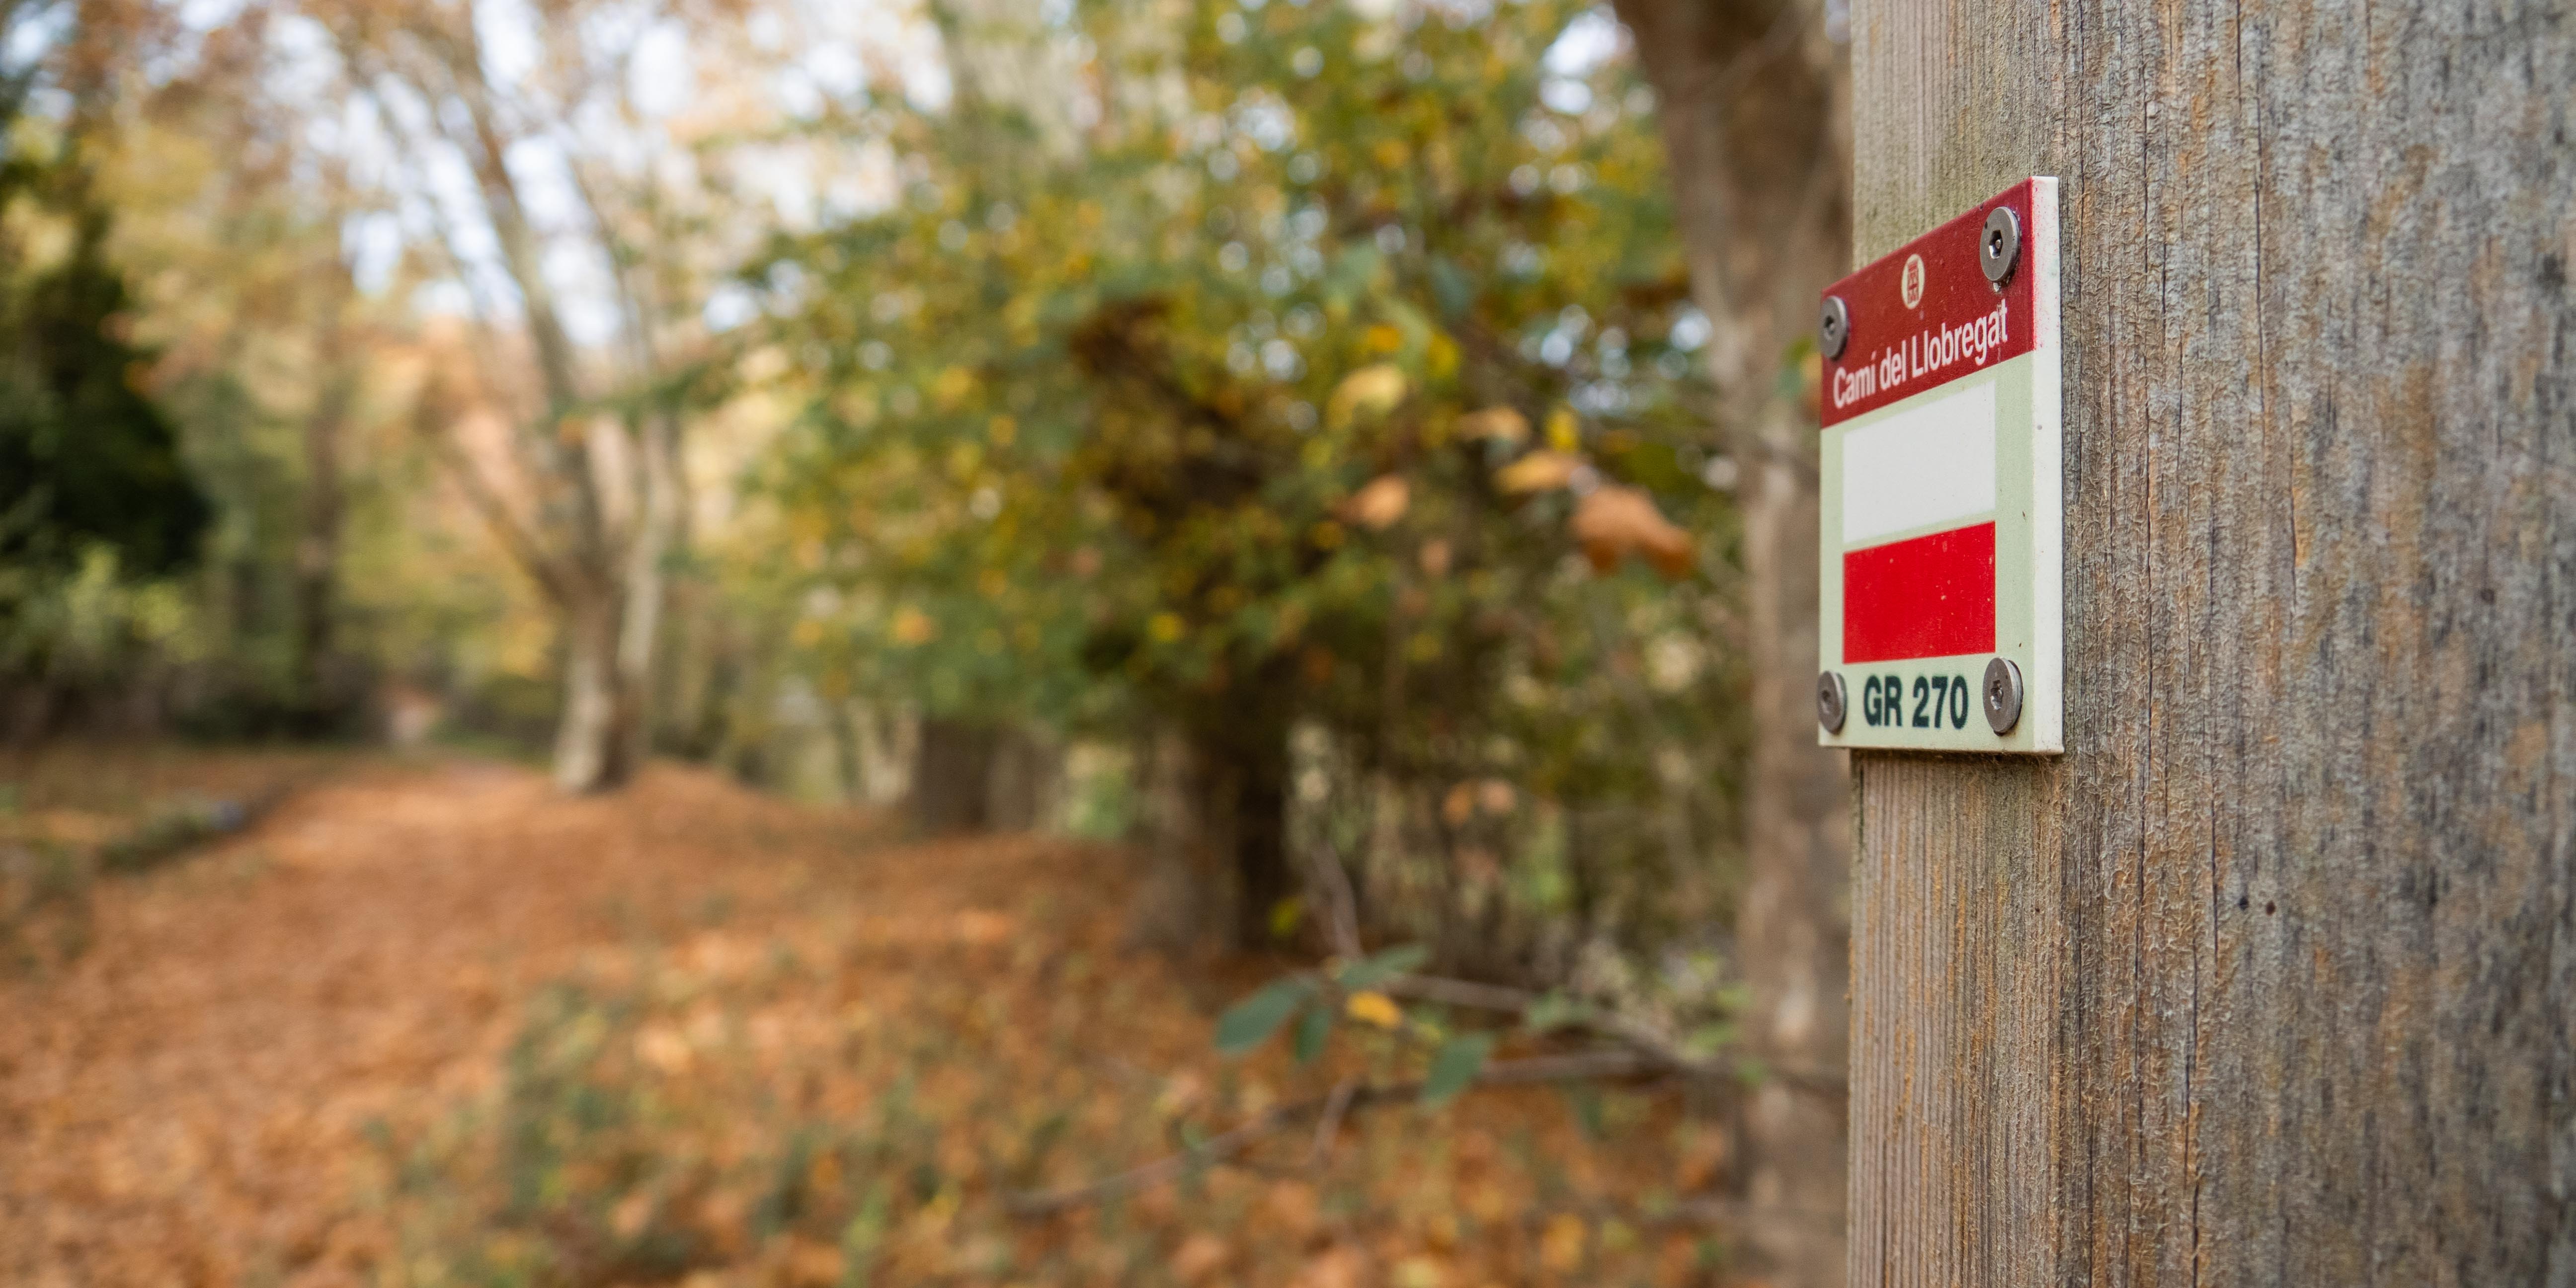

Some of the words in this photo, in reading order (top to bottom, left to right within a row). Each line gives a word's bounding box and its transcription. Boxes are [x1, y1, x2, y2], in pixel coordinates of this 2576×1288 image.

[1833, 350, 1876, 409] Camí
[1879, 339, 1907, 391] del
[1911, 299, 2008, 378] Llobregat
[1863, 675, 1903, 727] GR
[1912, 675, 1969, 729] 270
